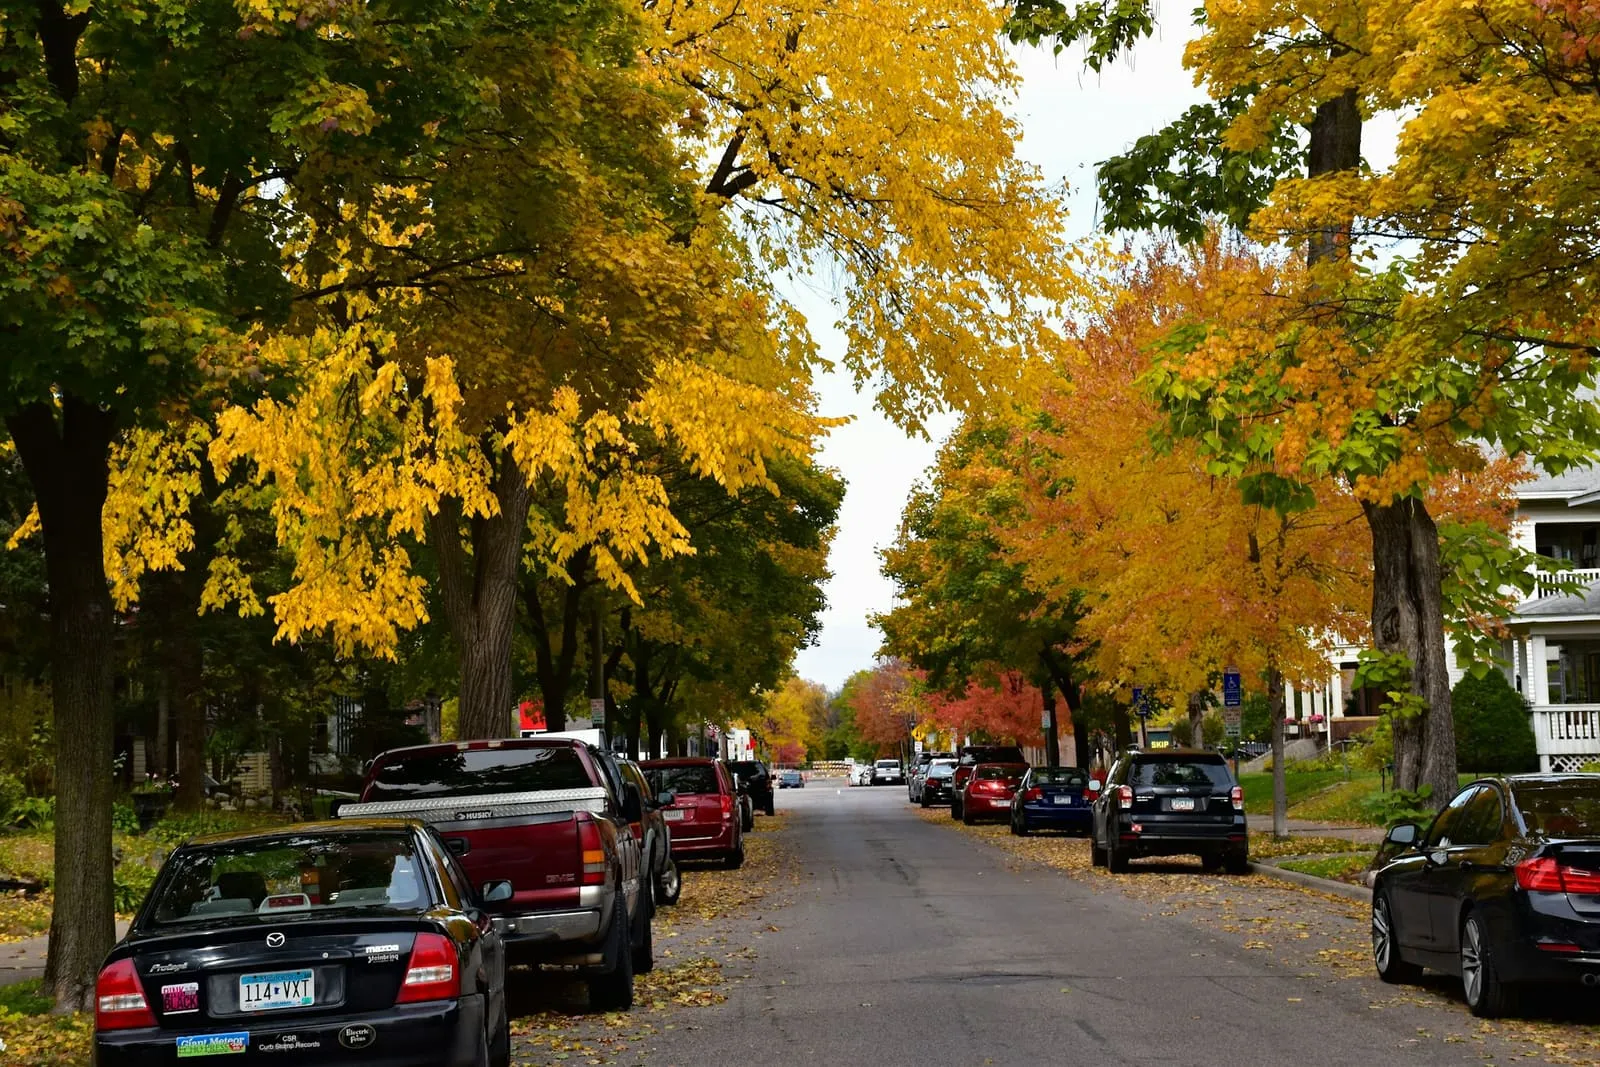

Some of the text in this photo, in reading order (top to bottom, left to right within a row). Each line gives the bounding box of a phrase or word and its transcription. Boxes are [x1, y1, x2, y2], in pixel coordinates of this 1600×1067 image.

[466, 811, 492, 819] HUSKY
[546, 873, 575, 883] GMC
[245, 979, 310, 1002] 114 VXT
[163, 995, 198, 1011] BLACK
[282, 1034, 297, 1042] CSR
[295, 1041, 321, 1049] Records
